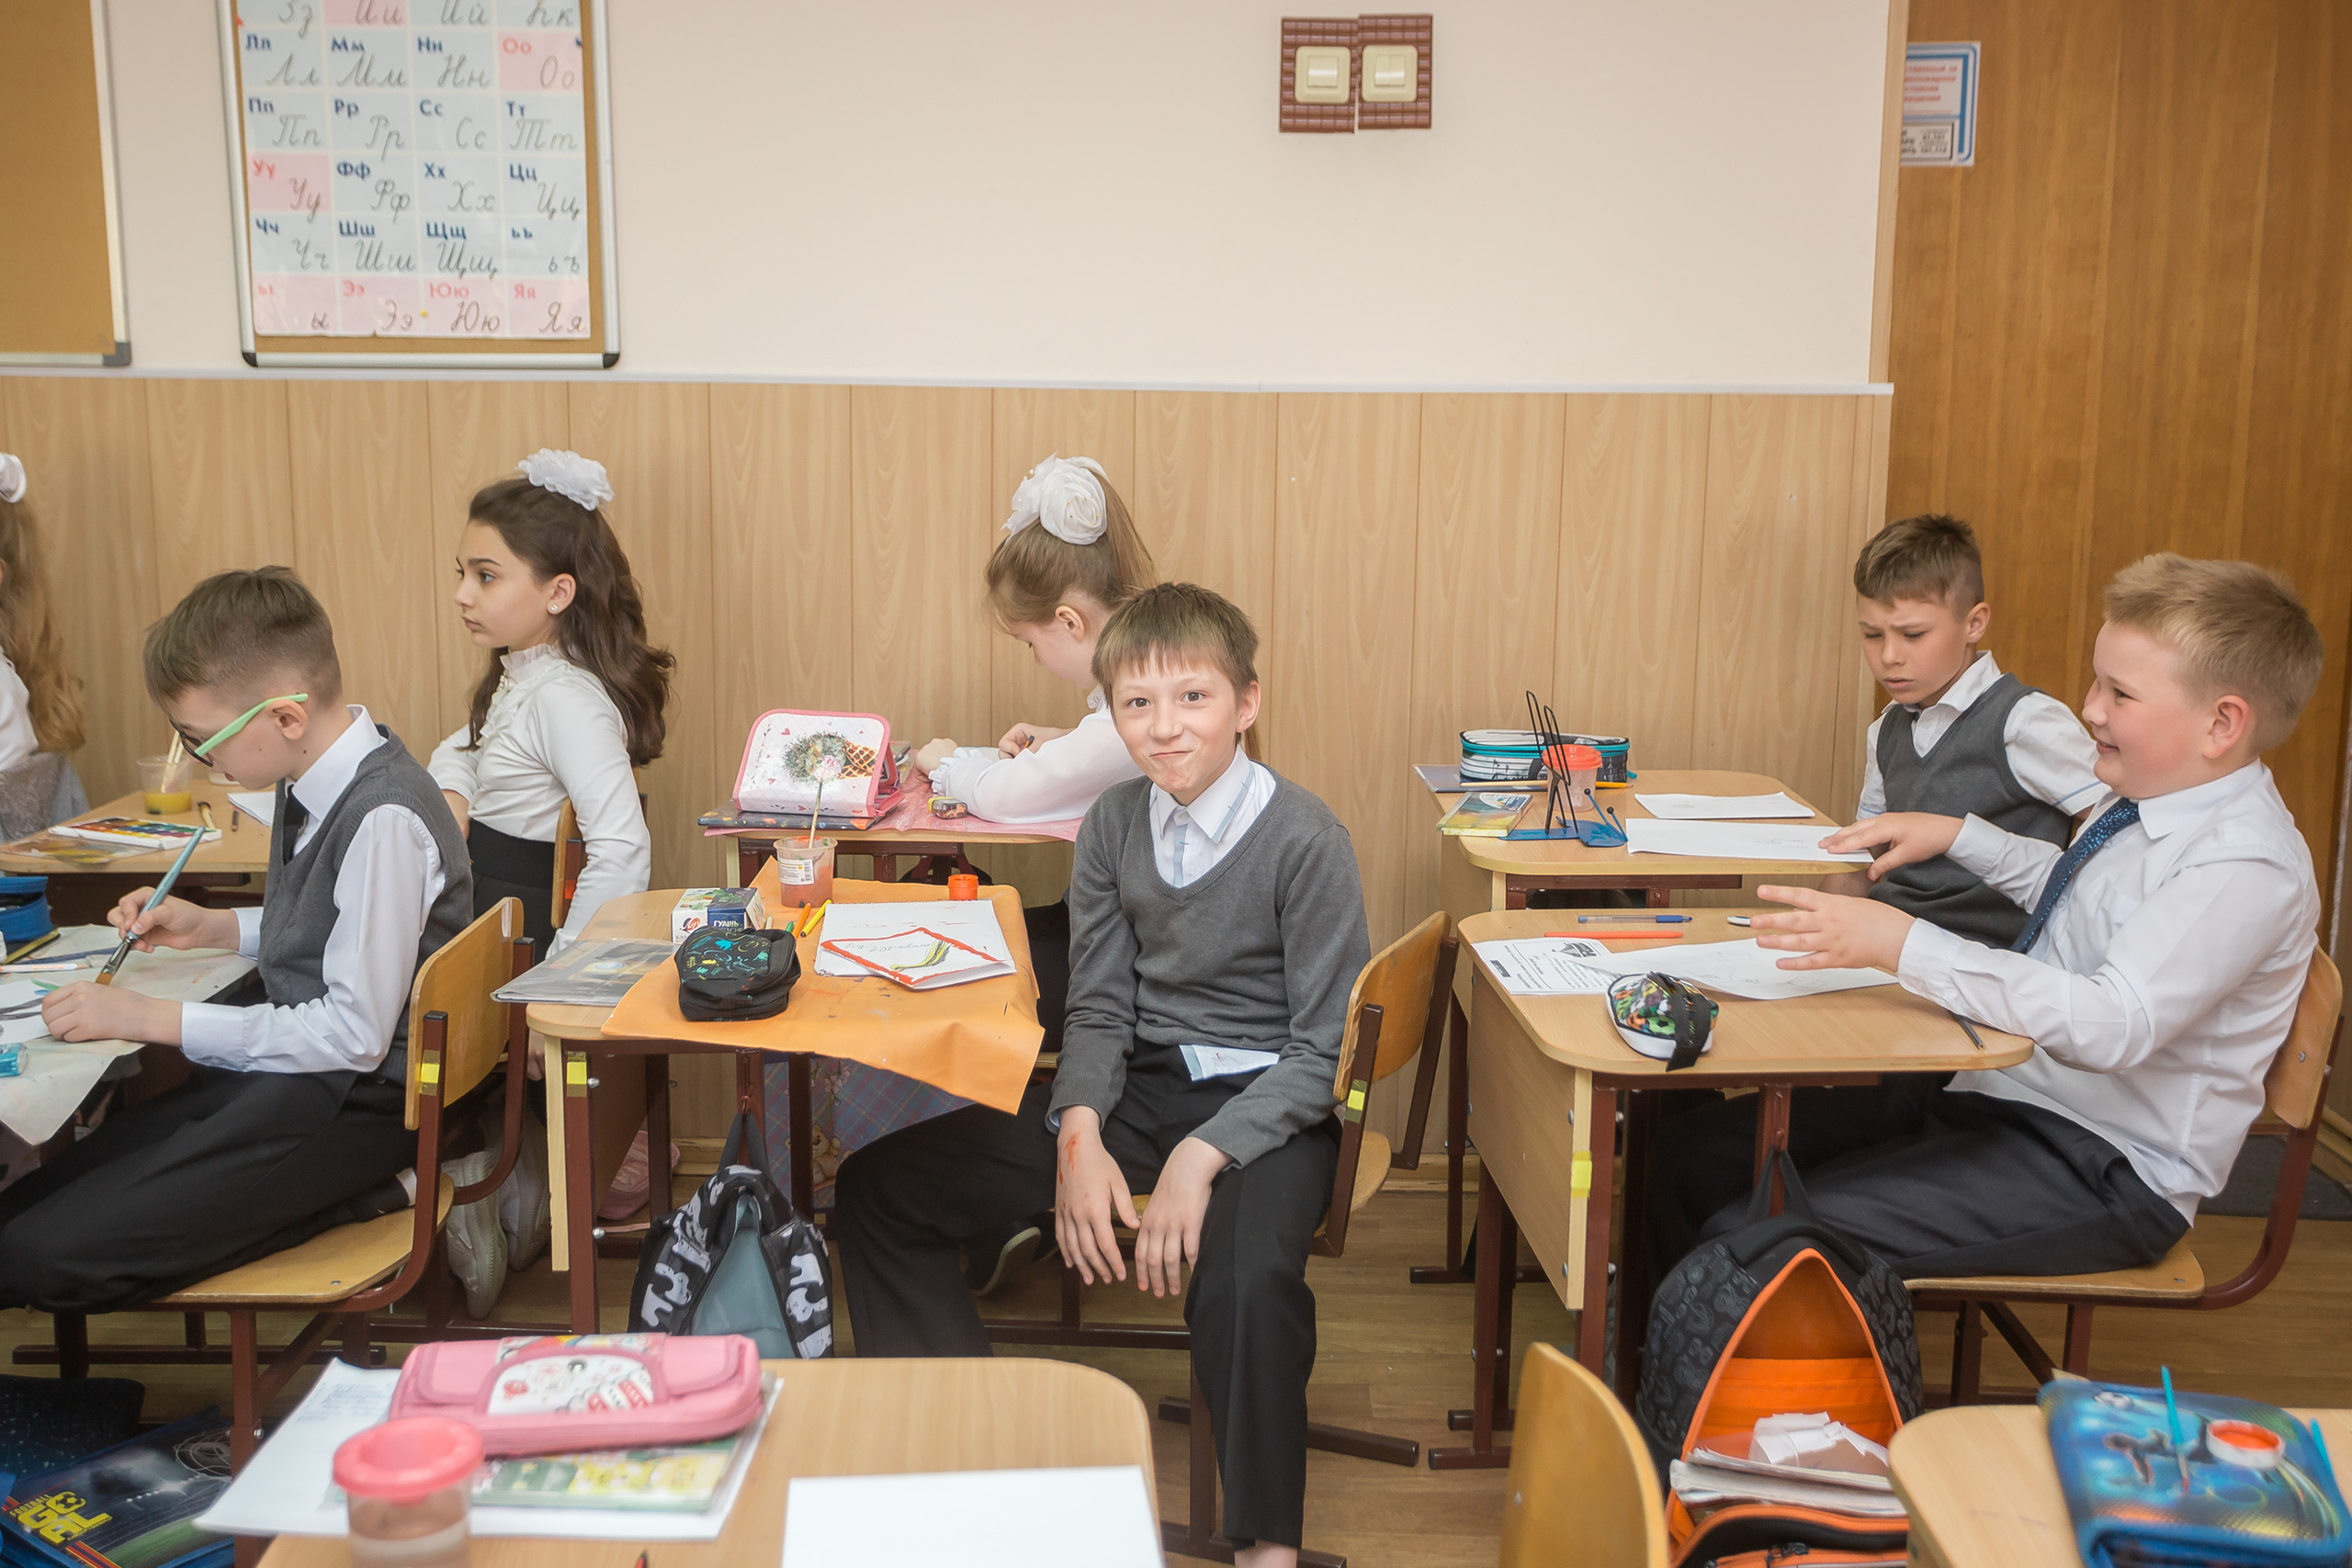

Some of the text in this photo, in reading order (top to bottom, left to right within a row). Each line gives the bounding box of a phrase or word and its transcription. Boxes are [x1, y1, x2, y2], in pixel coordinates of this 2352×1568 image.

[245, 33, 532, 55] Лл Мм Нн Оо
[266, 51, 575, 89] Лл Мм Нн Оо
[248, 96, 526, 118] Пп Рр Сс Тт
[271, 113, 578, 162] Пп Рр Сс Тт
[253, 159, 537, 182] Уу Фф Хх Цц
[288, 176, 581, 225] Уу Фф Хх Цц
[254, 219, 534, 240] Чч Шш Щщ ьъ
[292, 238, 581, 280] Чч Шш Щщ ьъ
[257, 280, 536, 299] ы Ээ Юю Яя
[311, 299, 588, 333] ы Ээ Юю Яя
[713, 919, 740, 928] ГУАШЬ
[9, 1493, 54, 1517] FOOTBALL
